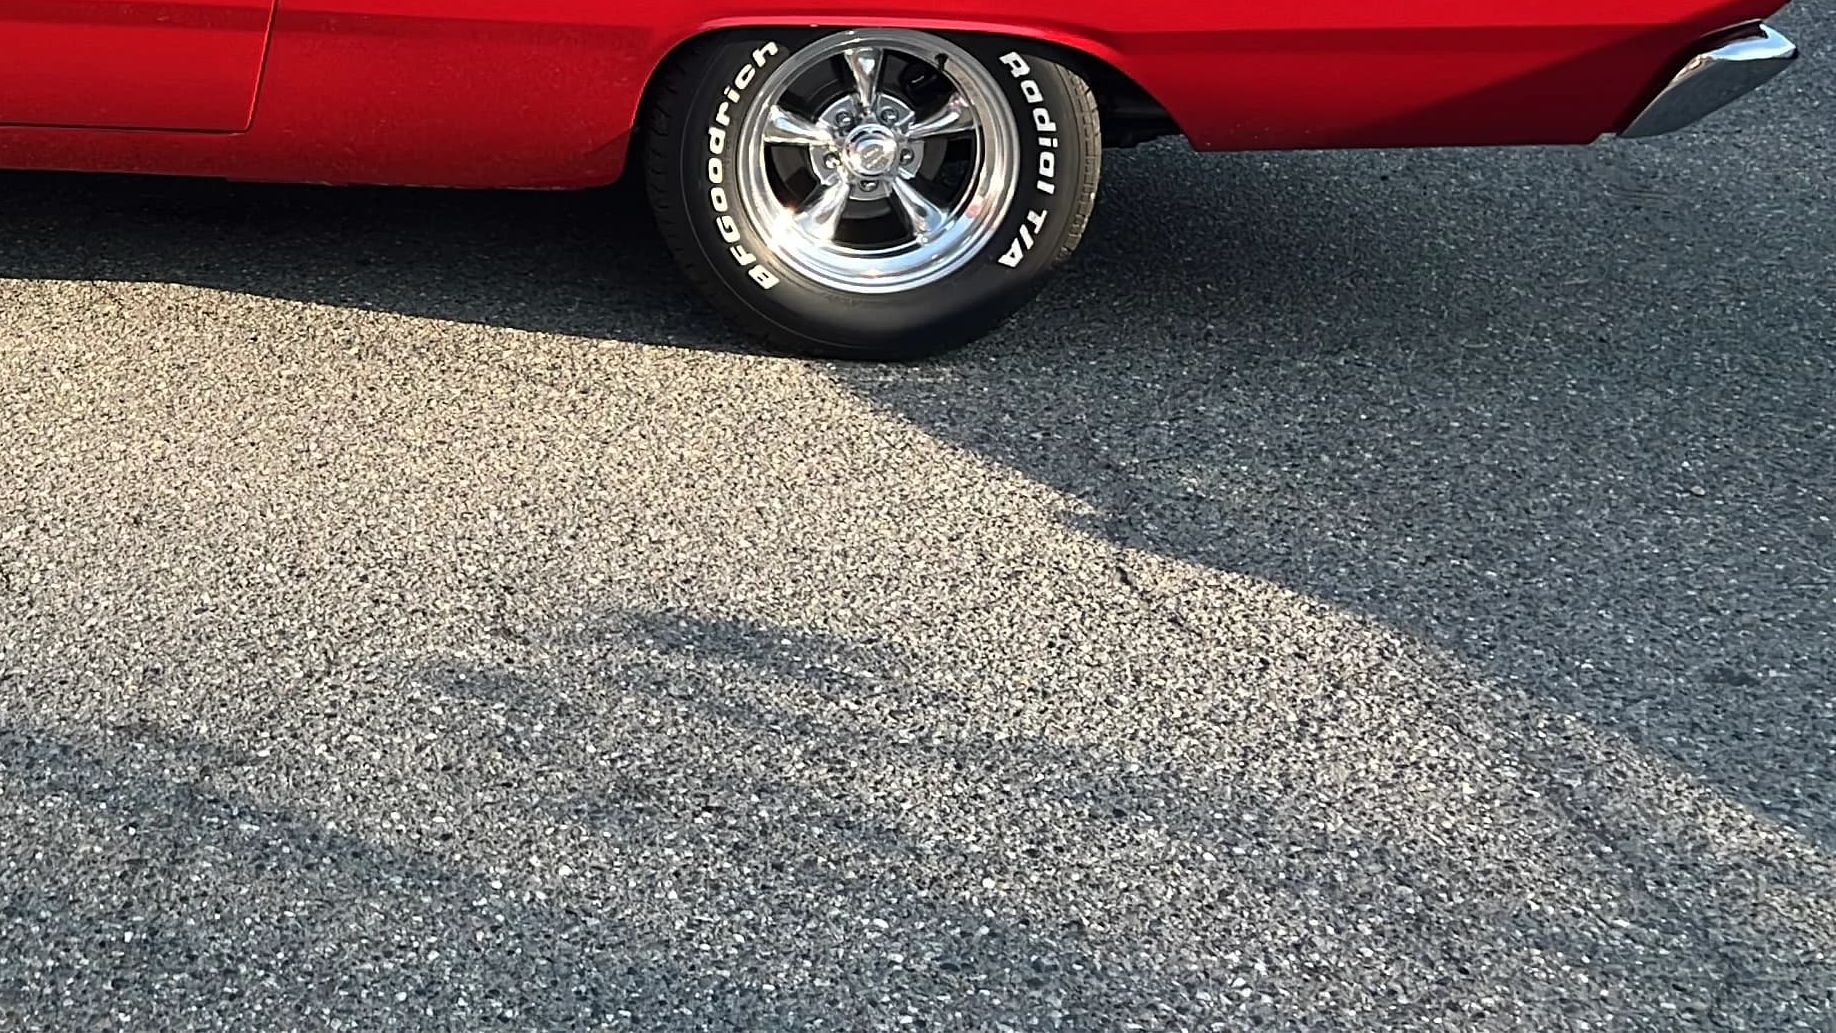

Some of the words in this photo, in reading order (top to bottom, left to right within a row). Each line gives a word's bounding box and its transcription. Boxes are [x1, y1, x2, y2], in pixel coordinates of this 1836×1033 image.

[707, 40, 780, 290] BFGoodrich
[999, 50, 1059, 195] Radial
[998, 208, 1048, 268] T/A
